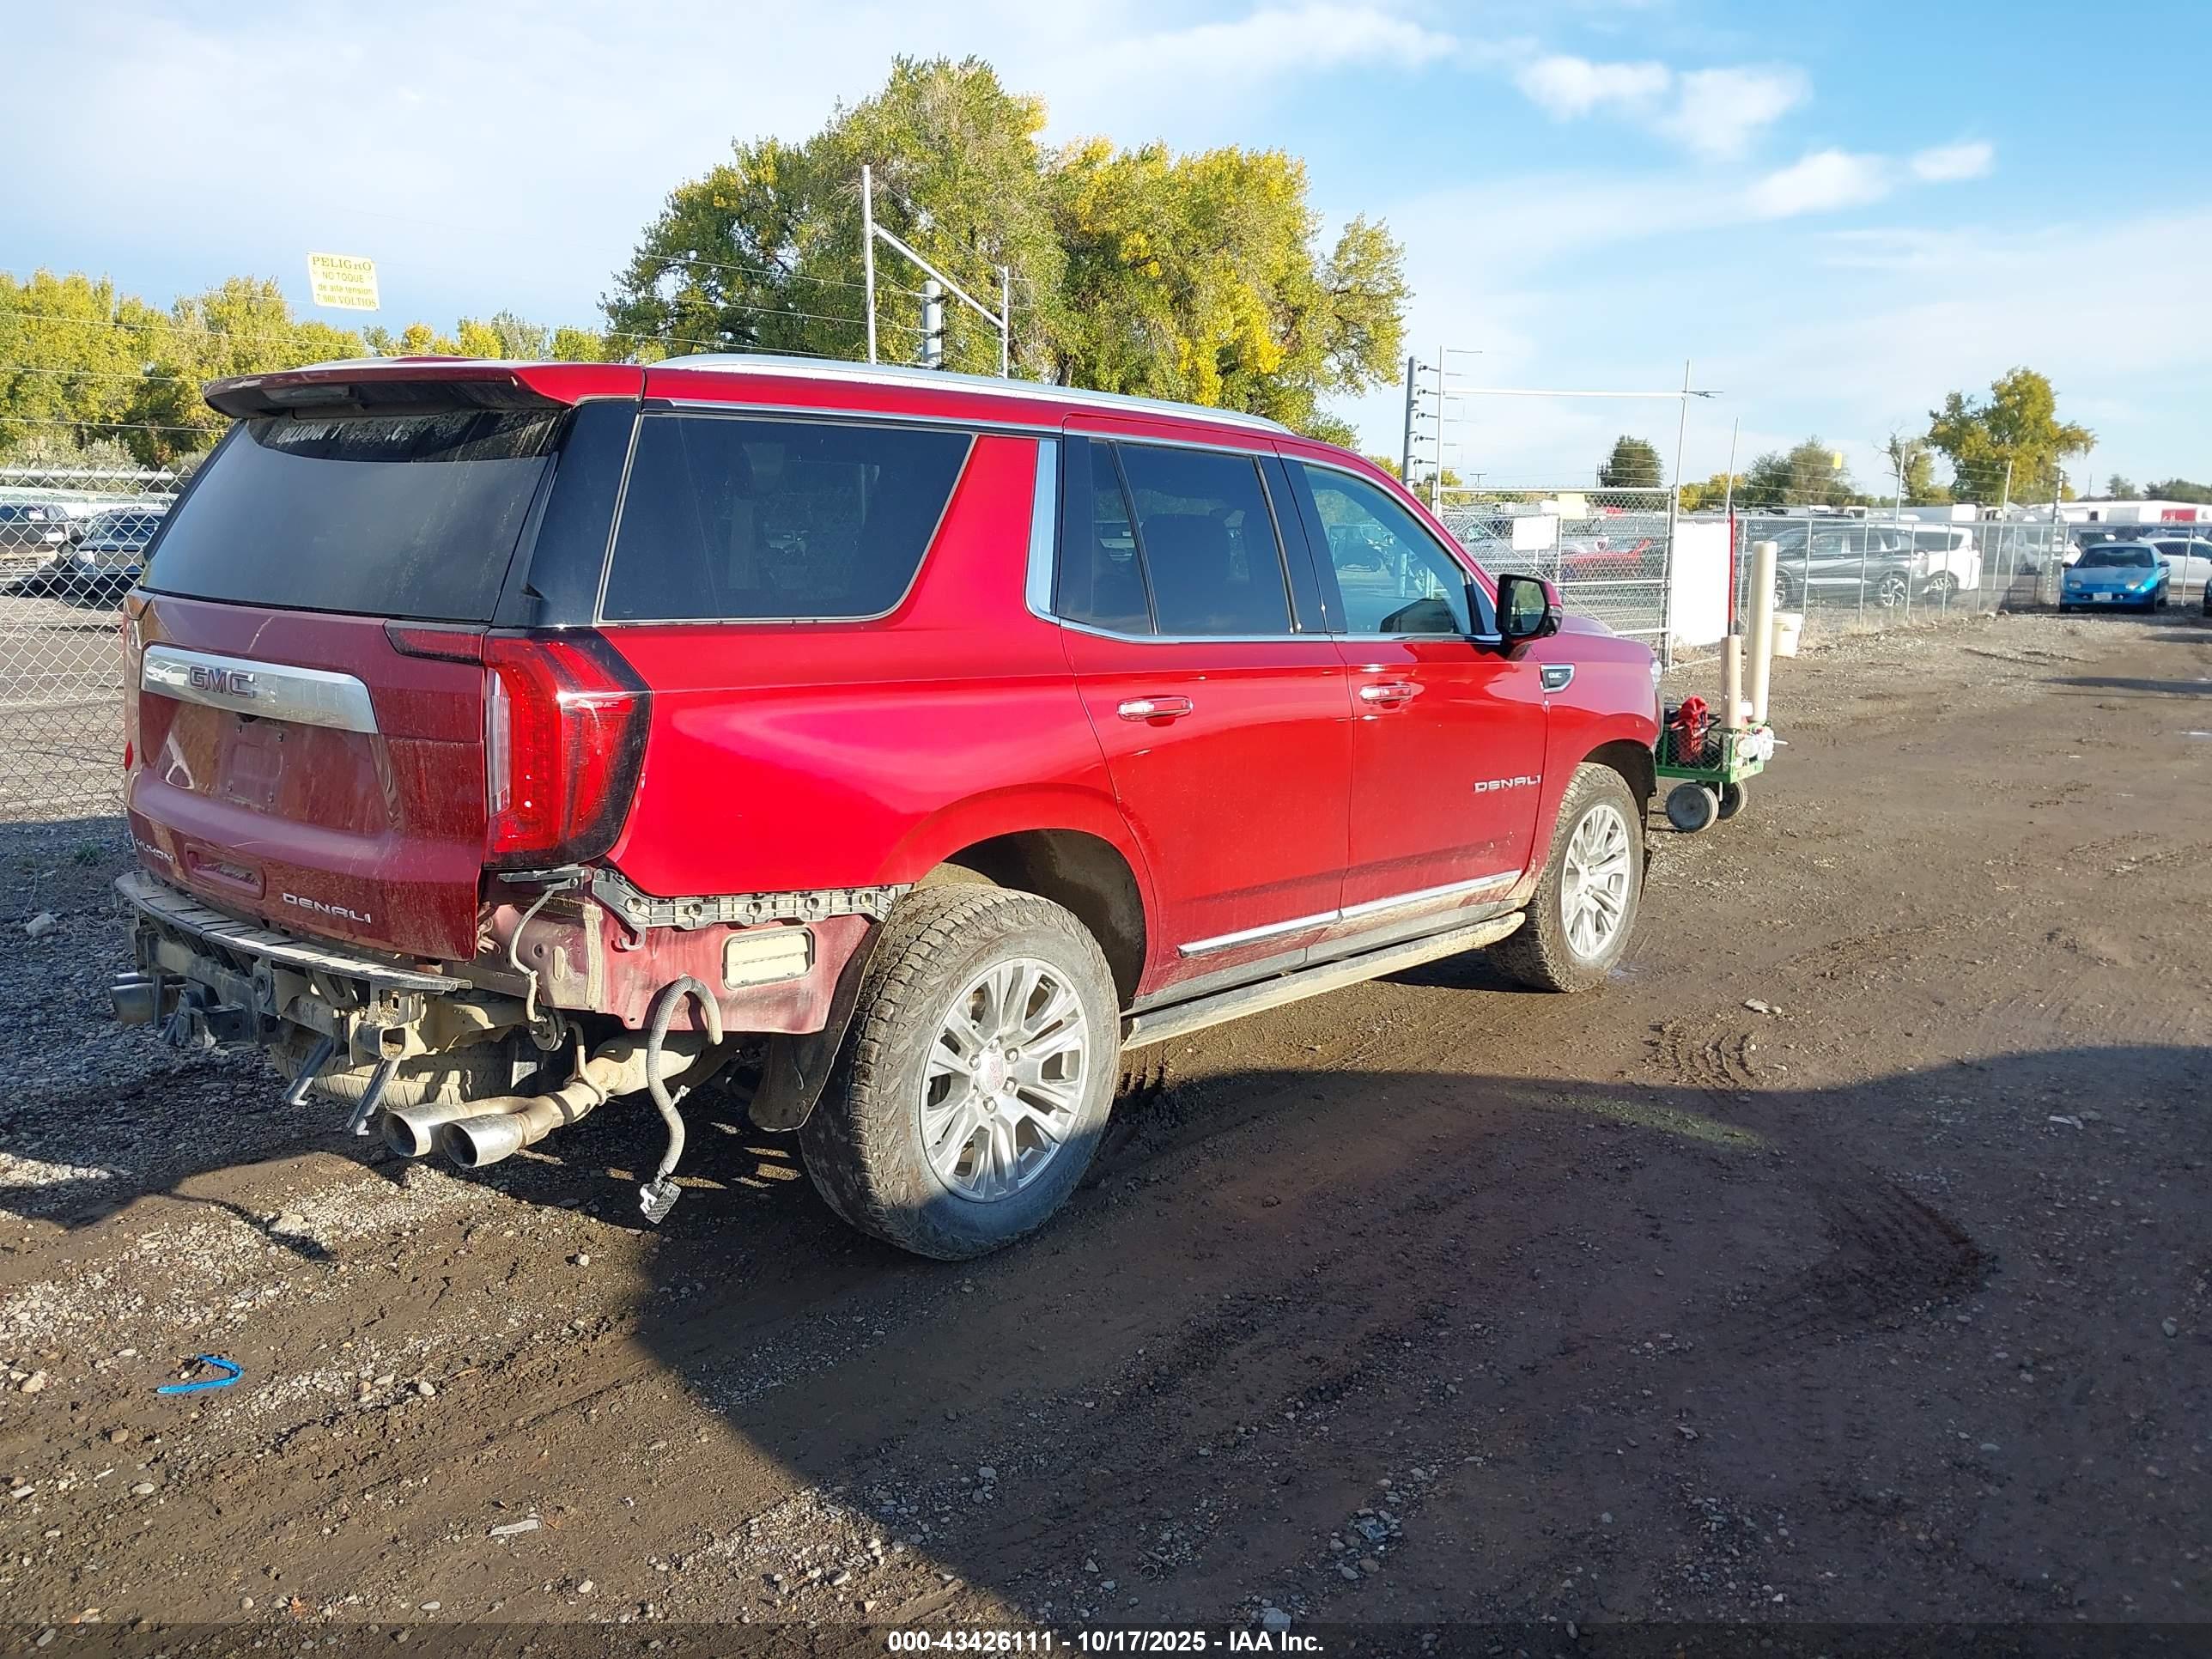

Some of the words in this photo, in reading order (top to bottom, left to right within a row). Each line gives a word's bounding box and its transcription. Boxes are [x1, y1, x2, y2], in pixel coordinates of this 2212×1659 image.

[312, 256, 372, 271] PELIGRO
[322, 270, 335, 280] NO
[336, 271, 365, 283] TOQUE
[190, 665, 255, 698] GMC
[1474, 775, 1541, 793] DENALI
[283, 892, 371, 925] DENALI
